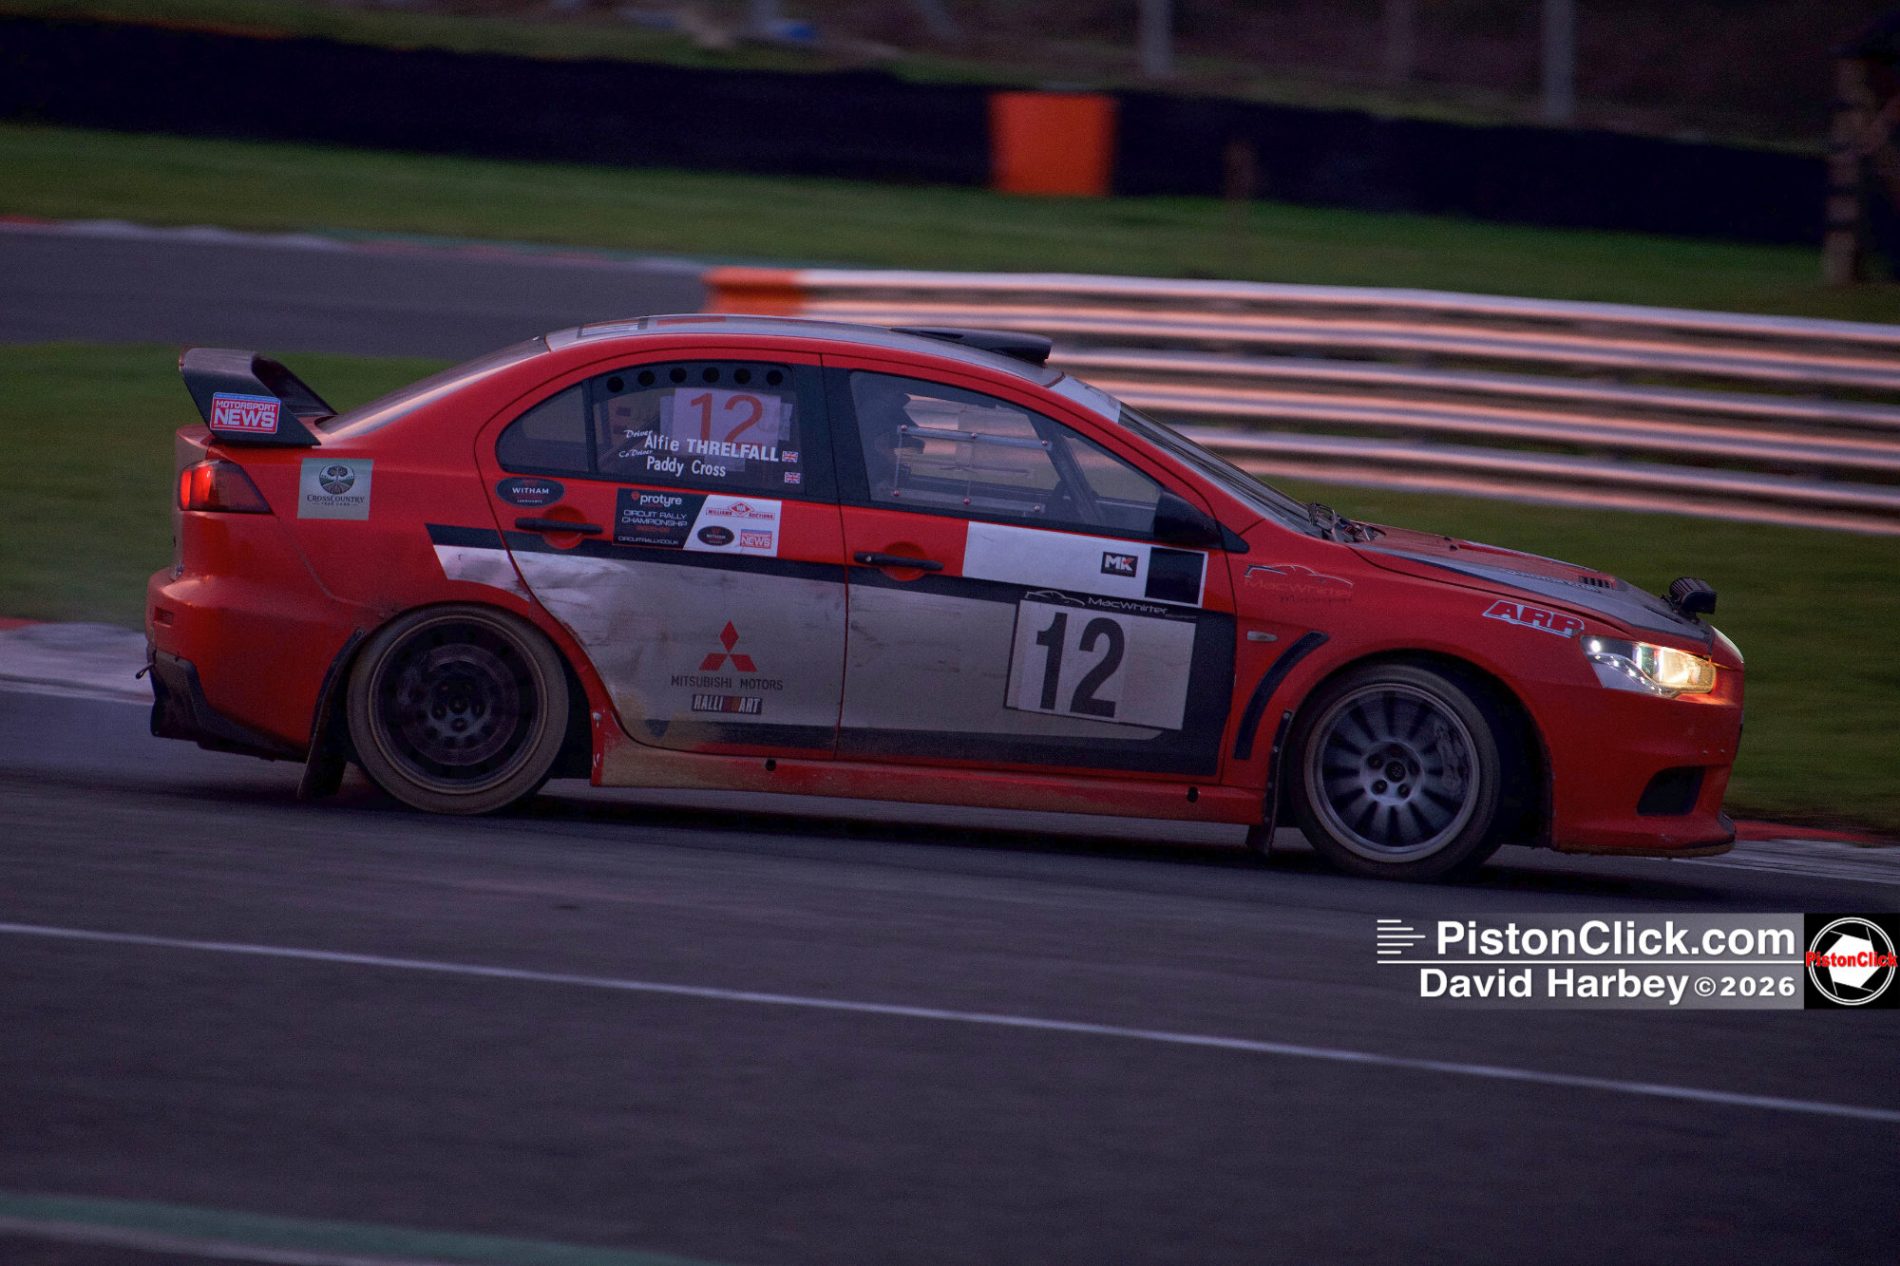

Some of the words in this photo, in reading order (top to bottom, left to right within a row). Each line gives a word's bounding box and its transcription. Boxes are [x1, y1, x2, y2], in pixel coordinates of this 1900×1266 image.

[216, 400, 276, 411] MOTORSPORT
[214, 408, 275, 427] NEWS
[690, 392, 766, 447] 12
[624, 429, 653, 438] Driver
[644, 435, 679, 451] Alfie
[687, 438, 779, 462] THRELFALL
[647, 456, 684, 478] Paddy
[691, 460, 726, 477] Cross
[640, 494, 682, 507] protyre
[621, 517, 688, 527] CHAMPIONSHIP
[623, 509, 658, 517] CIRCUIT
[659, 512, 688, 520] RALLY
[1104, 554, 1135, 571] MK
[1087, 596, 1168, 615] MacWhirter
[1482, 600, 1585, 638] ARP
[1036, 612, 1125, 718] 12
[671, 675, 732, 689] MITSUBISHI
[740, 678, 783, 691] MOTORS
